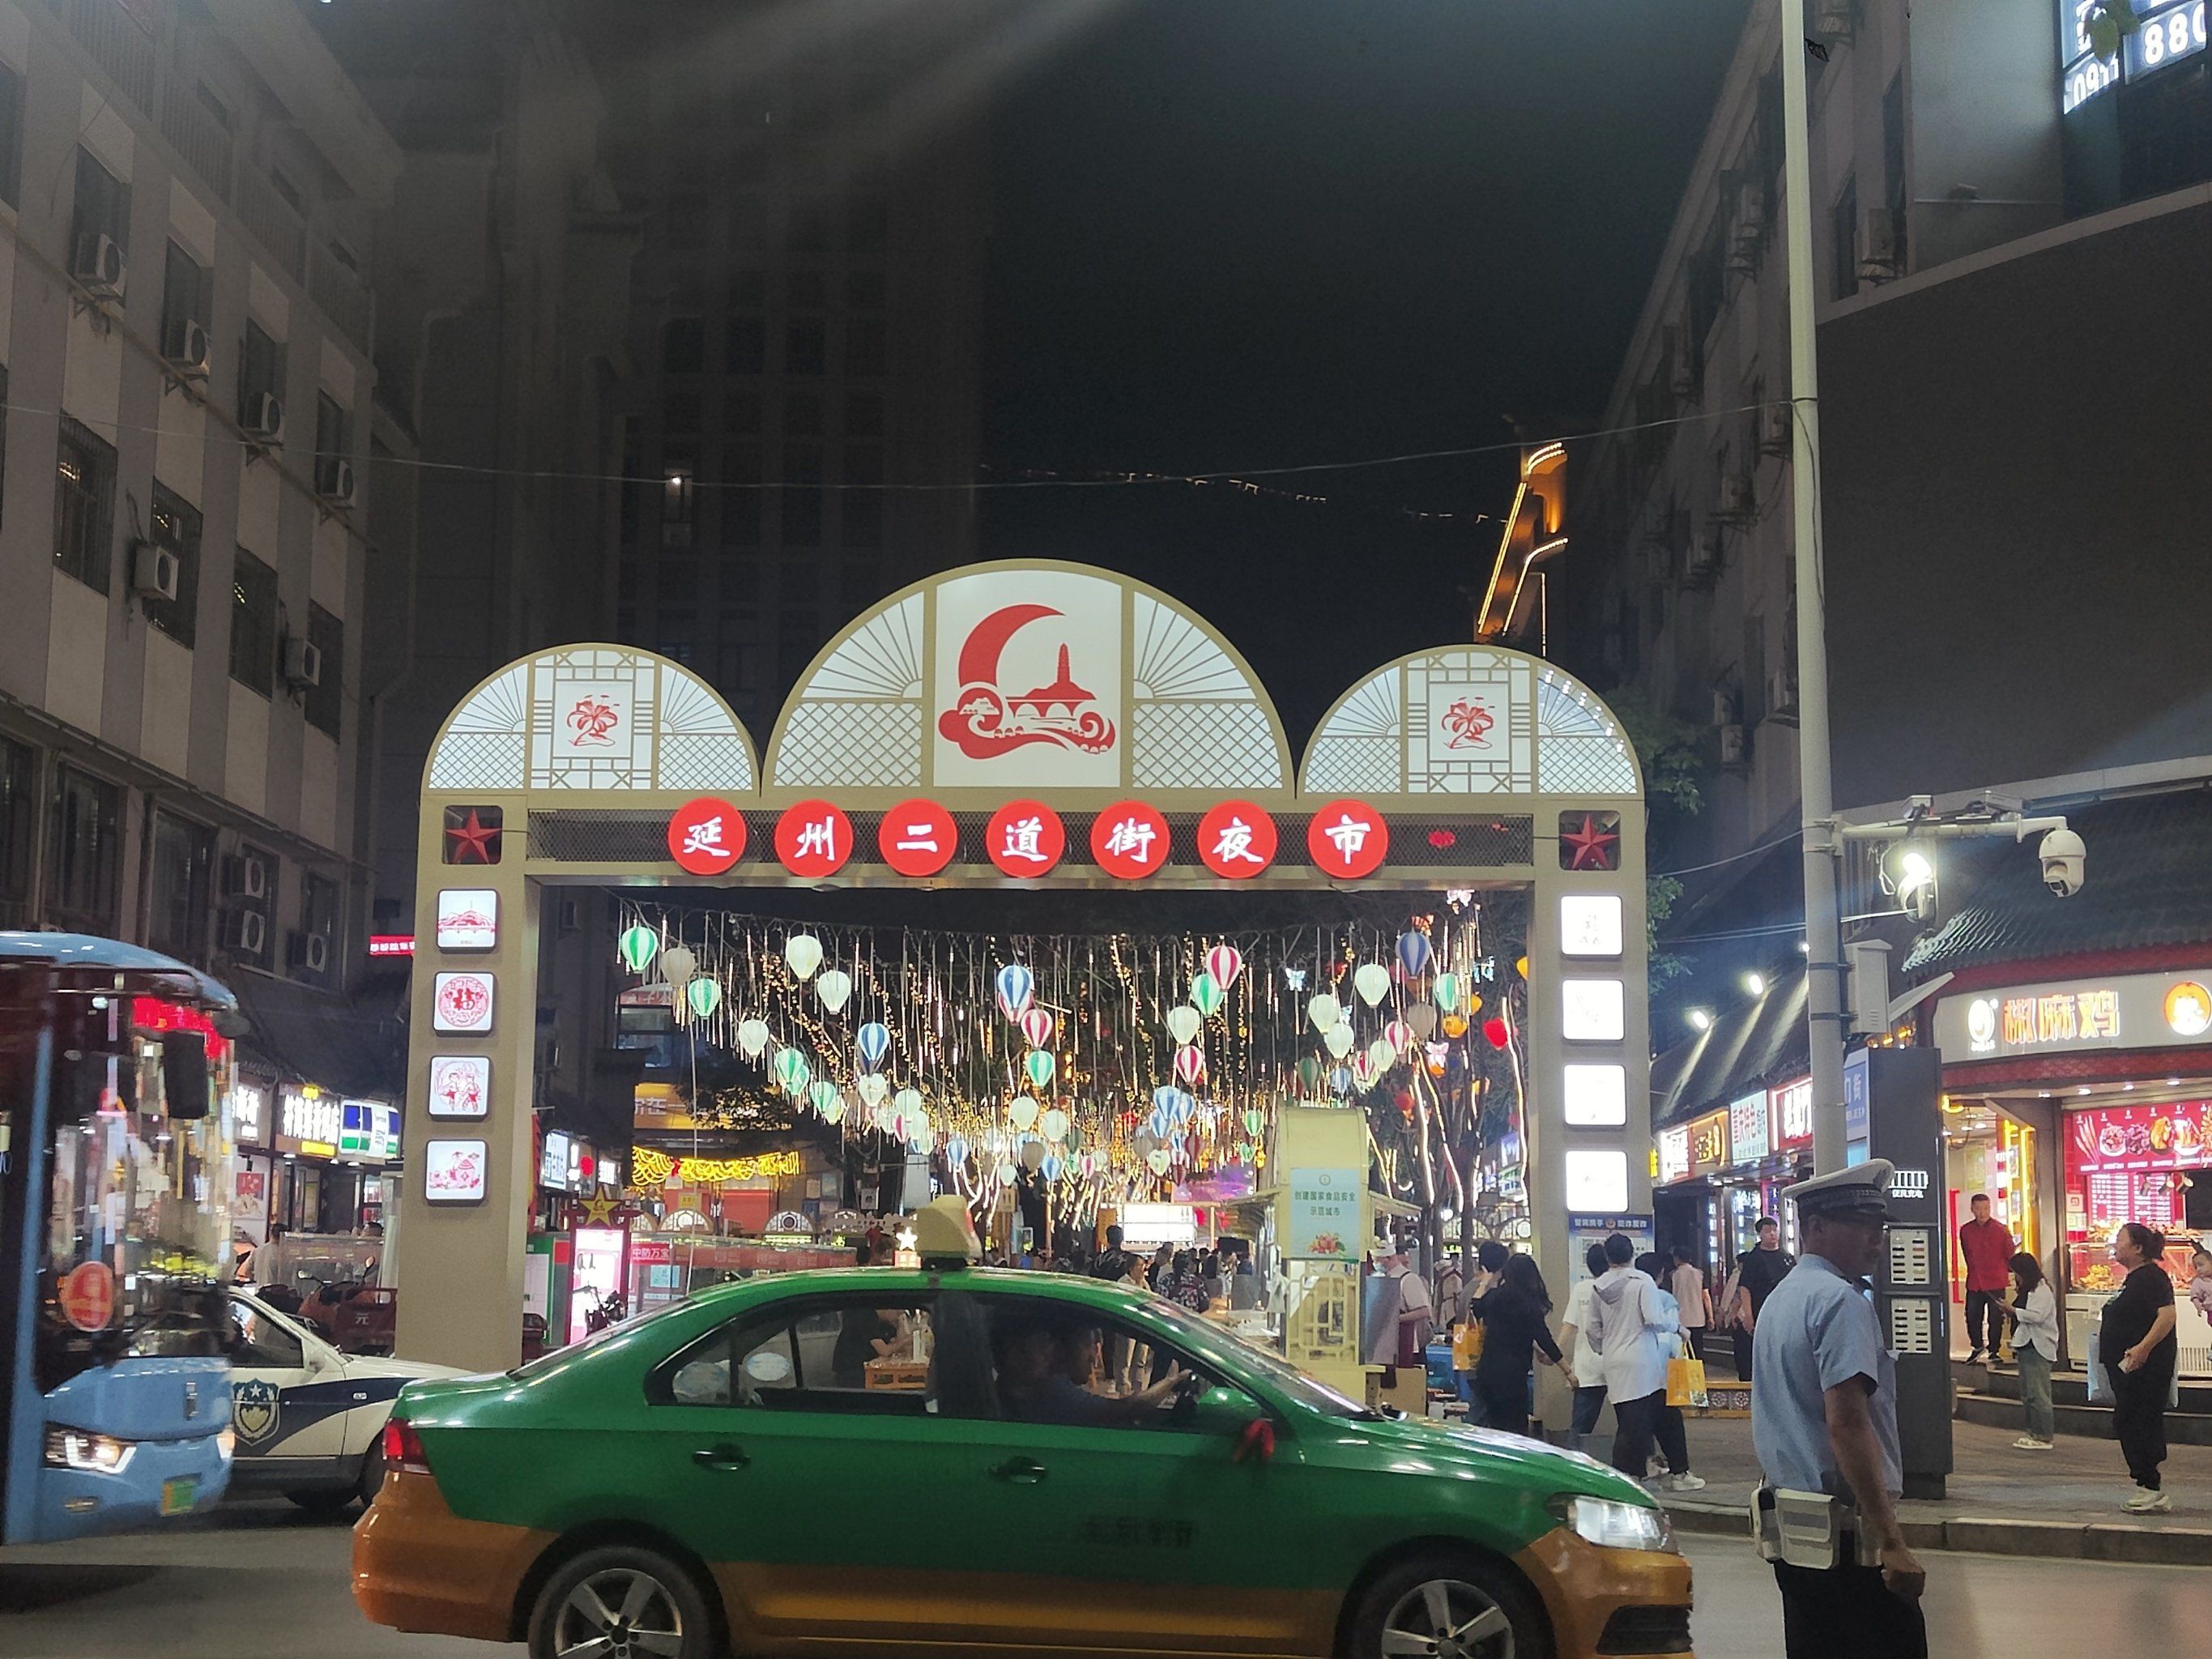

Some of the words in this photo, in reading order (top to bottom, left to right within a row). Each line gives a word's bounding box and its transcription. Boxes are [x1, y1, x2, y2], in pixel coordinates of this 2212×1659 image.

[683, 813, 1372, 864] 延州二道街夜市
[2003, 990, 2120, 1045] 椒麻鸡
[1294, 1191, 1356, 1202] 创建国家食品安全
[1310, 1206, 1341, 1216] 示范城市
